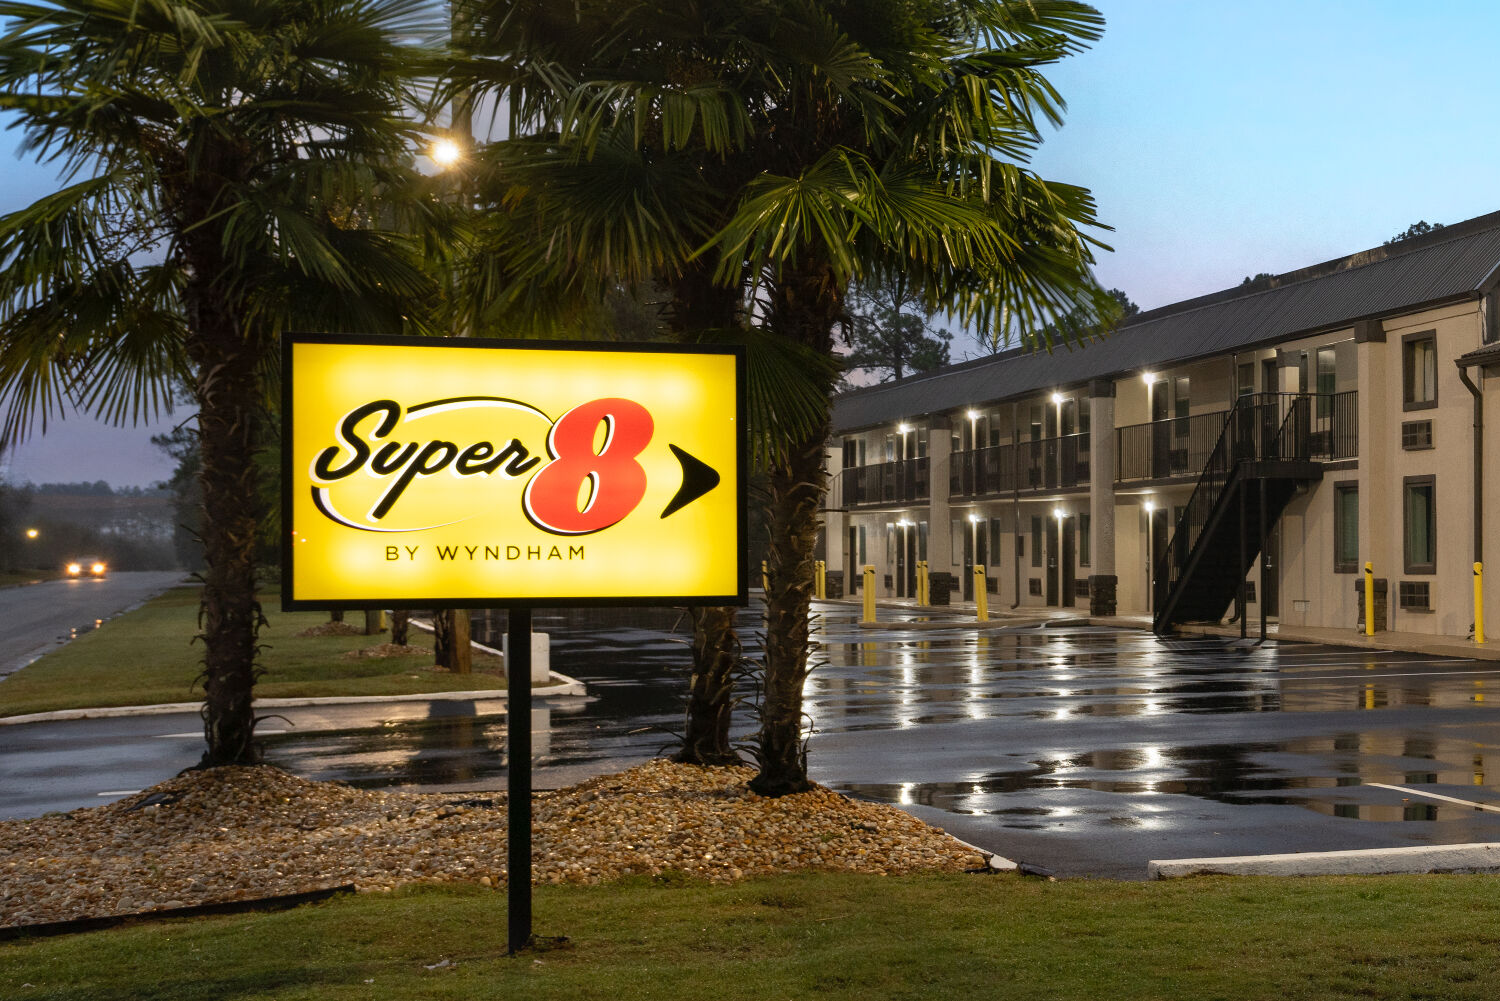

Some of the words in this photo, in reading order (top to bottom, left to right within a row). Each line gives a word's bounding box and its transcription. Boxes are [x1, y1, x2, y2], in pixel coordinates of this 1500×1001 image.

[314, 399, 541, 519] Super
[522, 397, 655, 536] 8
[386, 545, 418, 561] BY
[436, 545, 585, 561] WYNDHAM
